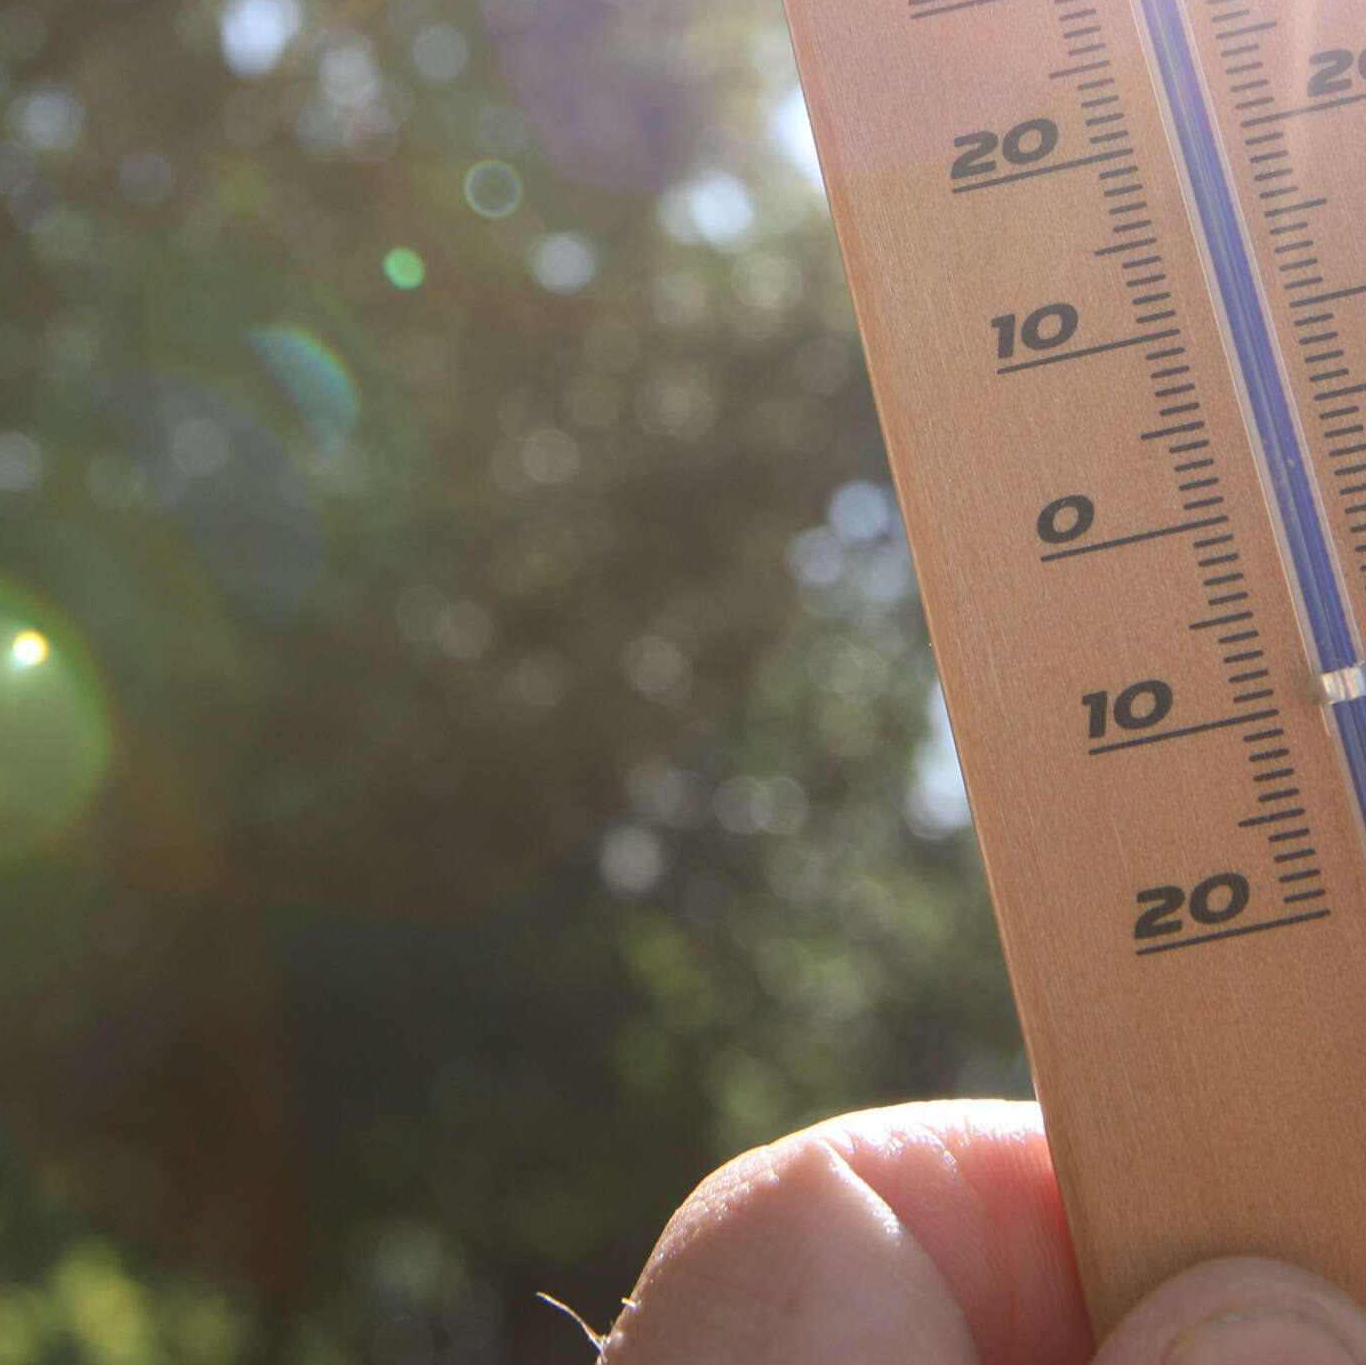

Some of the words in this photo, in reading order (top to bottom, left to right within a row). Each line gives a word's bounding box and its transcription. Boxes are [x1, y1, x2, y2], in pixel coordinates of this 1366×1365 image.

[950, 118, 1059, 180] 20
[990, 302, 1079, 359] 10
[1036, 494, 1095, 544] 0
[1081, 679, 1173, 738] 10
[1133, 872, 1250, 940] 20
